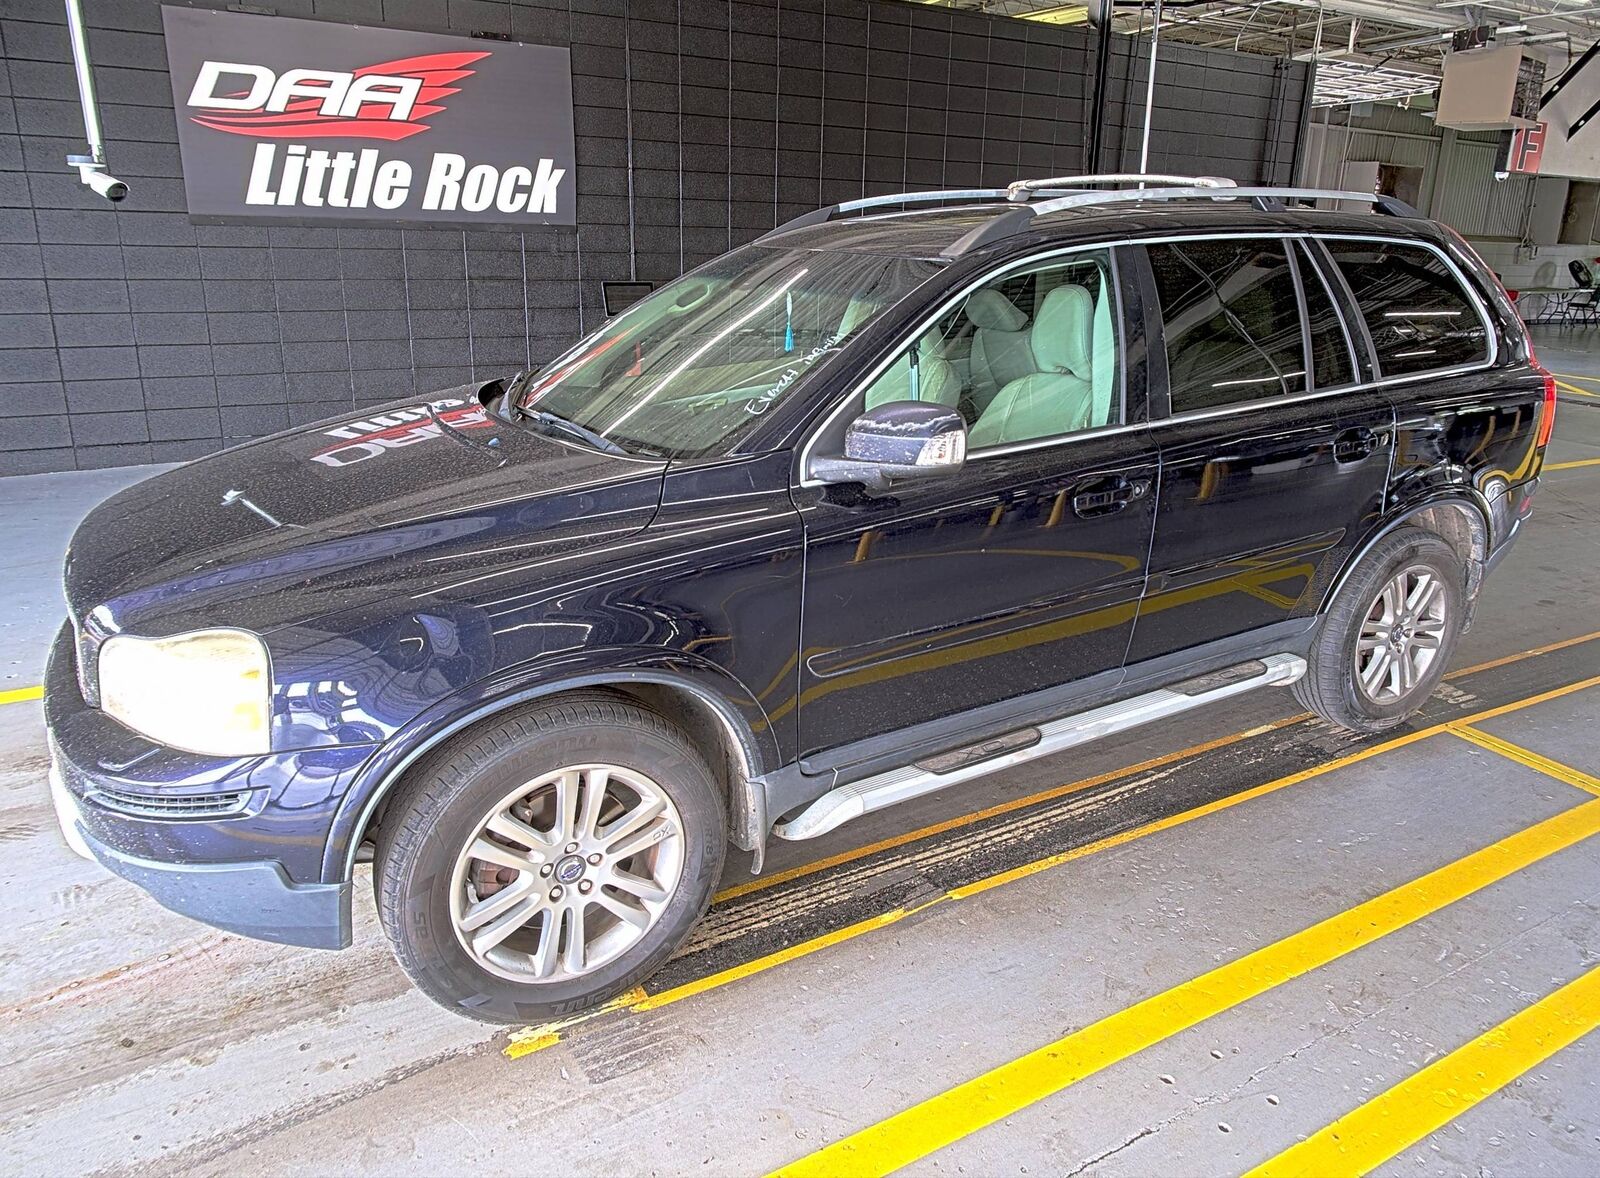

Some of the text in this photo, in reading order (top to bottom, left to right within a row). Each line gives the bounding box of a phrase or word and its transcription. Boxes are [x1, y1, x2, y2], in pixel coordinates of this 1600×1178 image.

[186, 60, 424, 121] DAA
[1516, 123, 1543, 171] F
[245, 143, 566, 214] Little Rock
